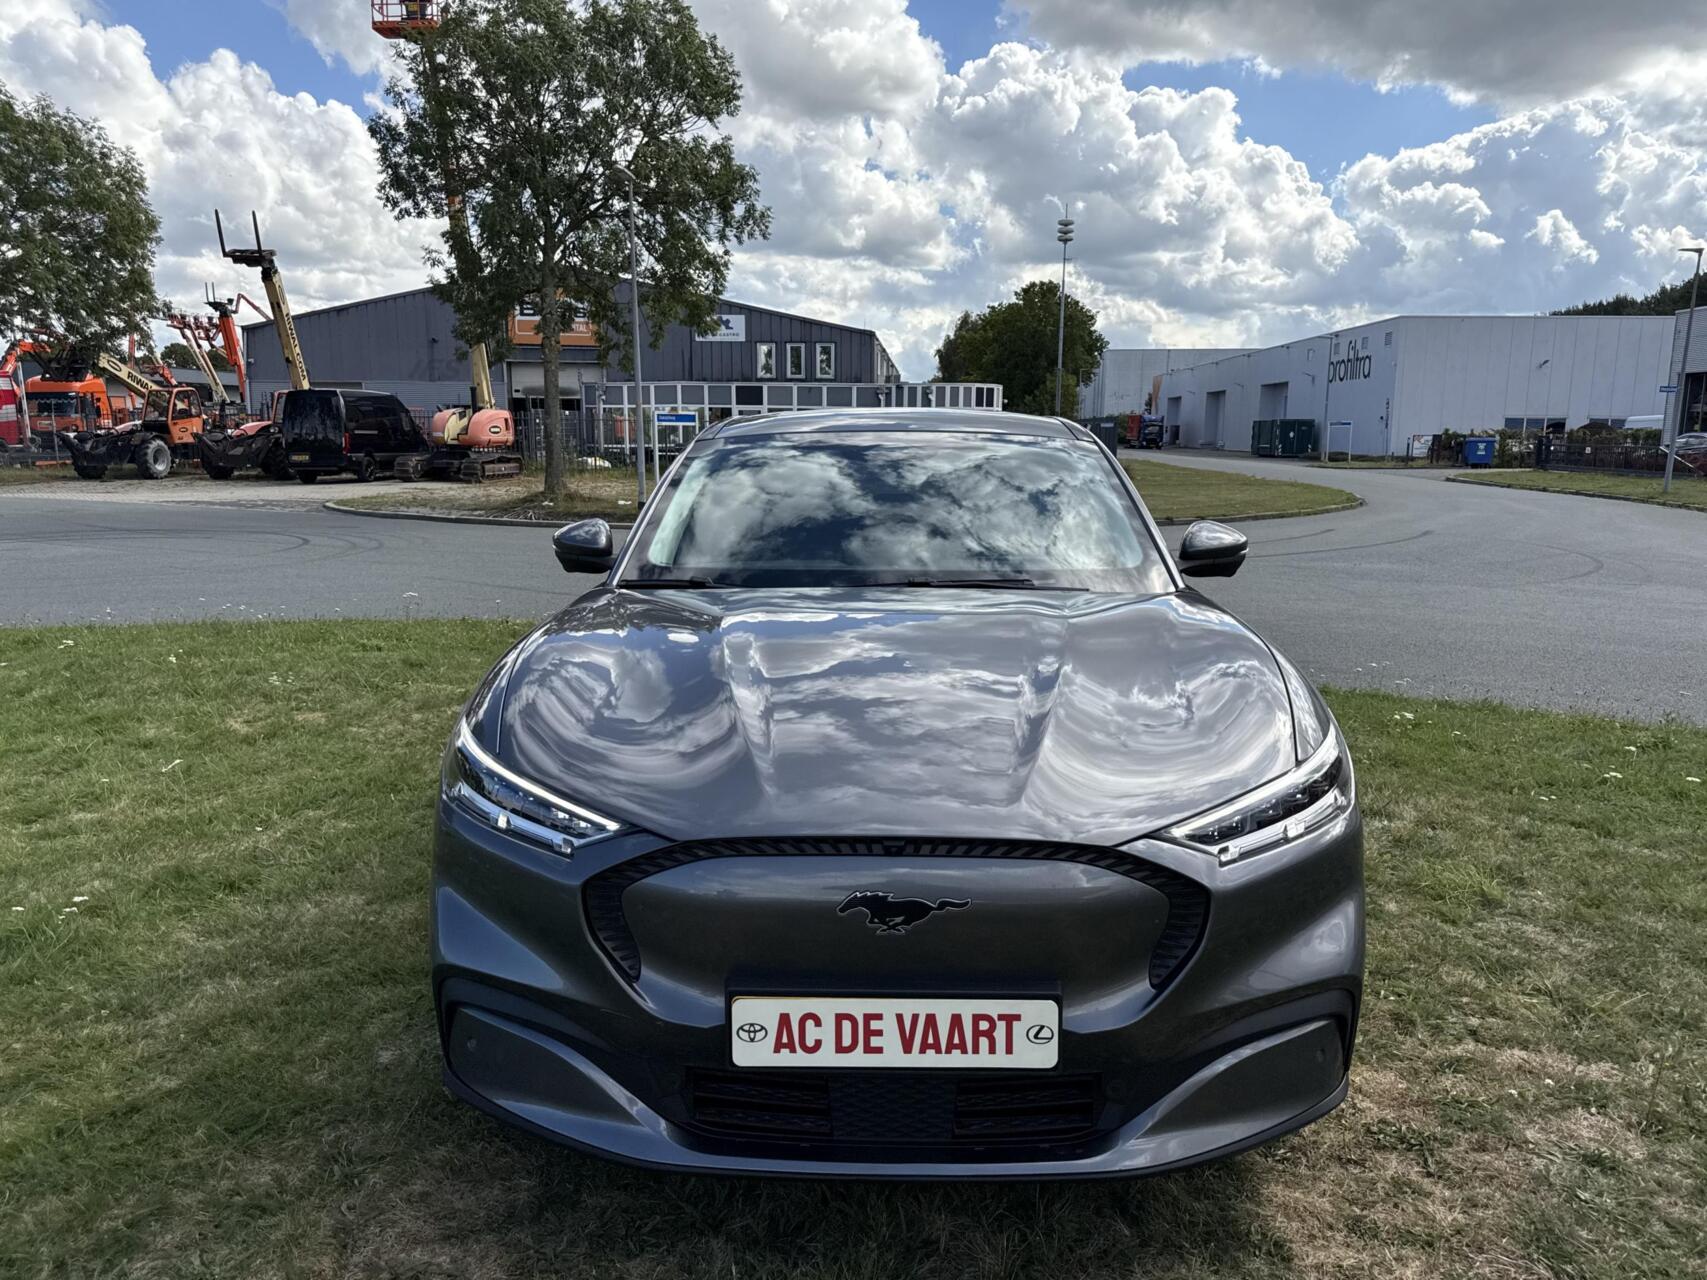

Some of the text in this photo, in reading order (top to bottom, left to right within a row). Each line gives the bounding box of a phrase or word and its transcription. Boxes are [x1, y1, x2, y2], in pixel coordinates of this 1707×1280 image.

[772, 1012, 1022, 1056] AC DE VAART
